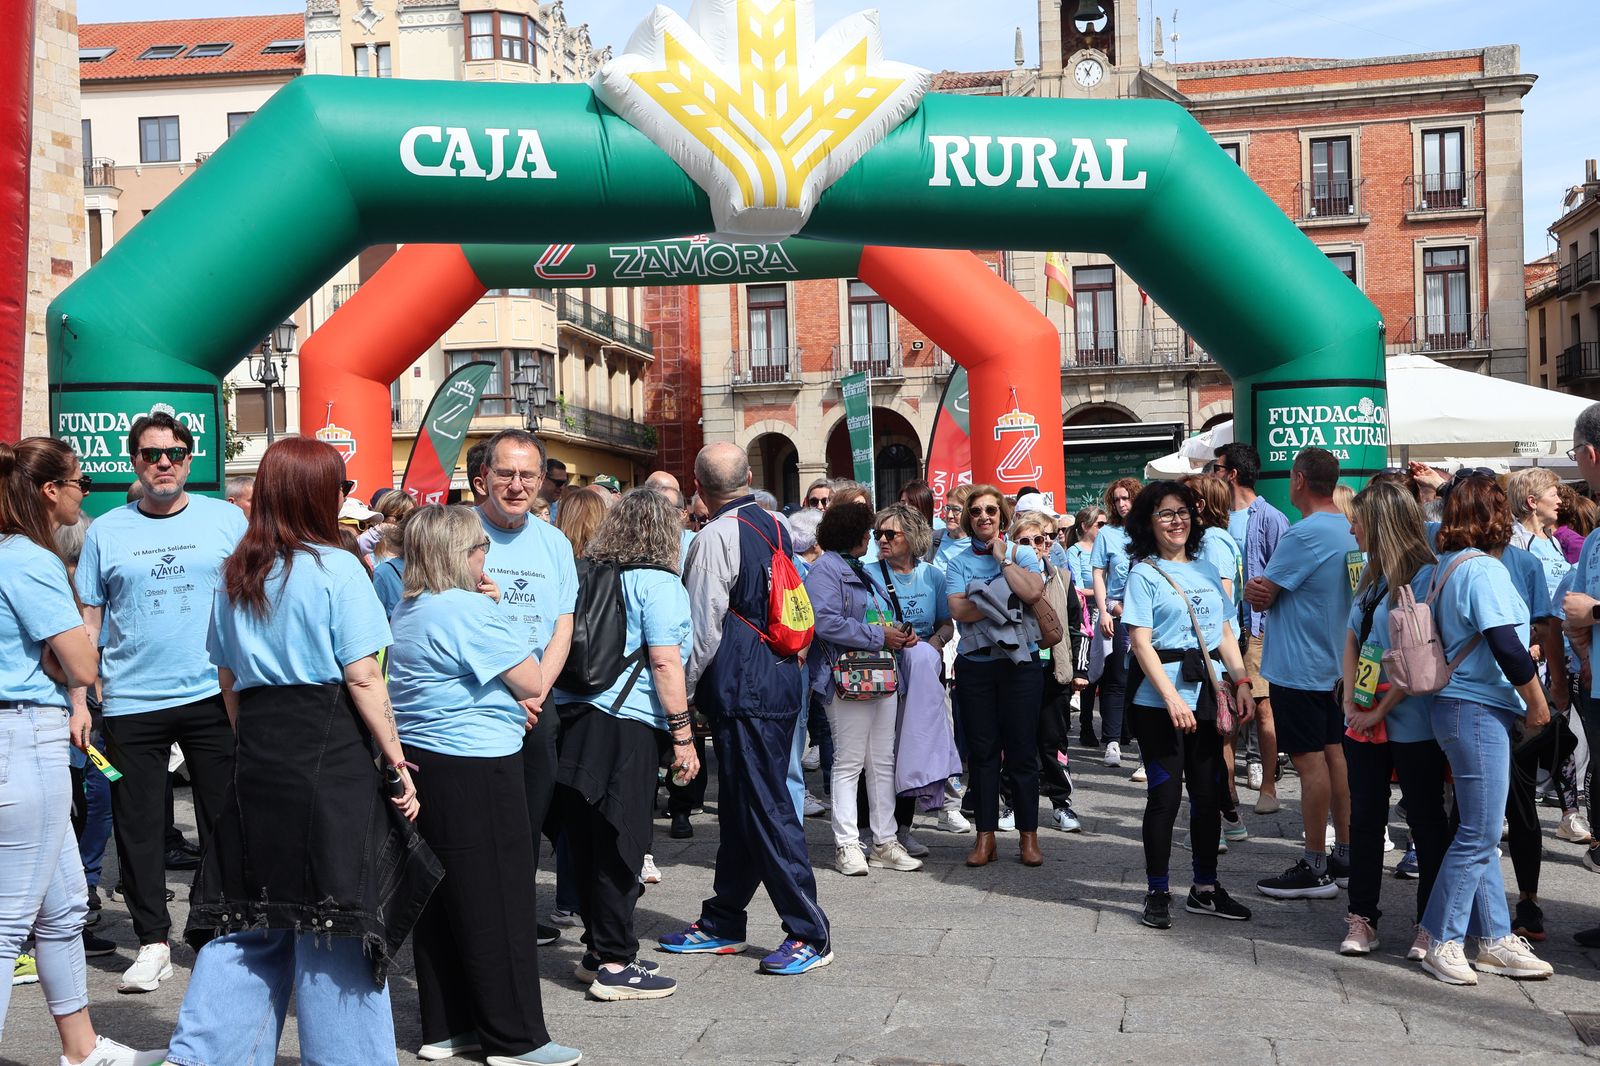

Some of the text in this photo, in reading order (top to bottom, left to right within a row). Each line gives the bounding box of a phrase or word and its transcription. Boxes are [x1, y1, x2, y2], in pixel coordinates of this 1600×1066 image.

[399, 125, 558, 181] CAJA
[928, 135, 1148, 190] RURAL
[608, 241, 799, 279] ZAMORA
[58, 412, 206, 433] FUNDAON
[1268, 426, 1387, 448] CAJA RURAL
[1270, 449, 1350, 462] DE ZRA
[141, 547, 166, 556] Marcha
[167, 543, 197, 552] Solidaria
[150, 563, 186, 580] AZAYCA
[497, 567, 520, 576] Marcha
[520, 569, 546, 580] Solidaria
[503, 587, 536, 605] AZAYCA
